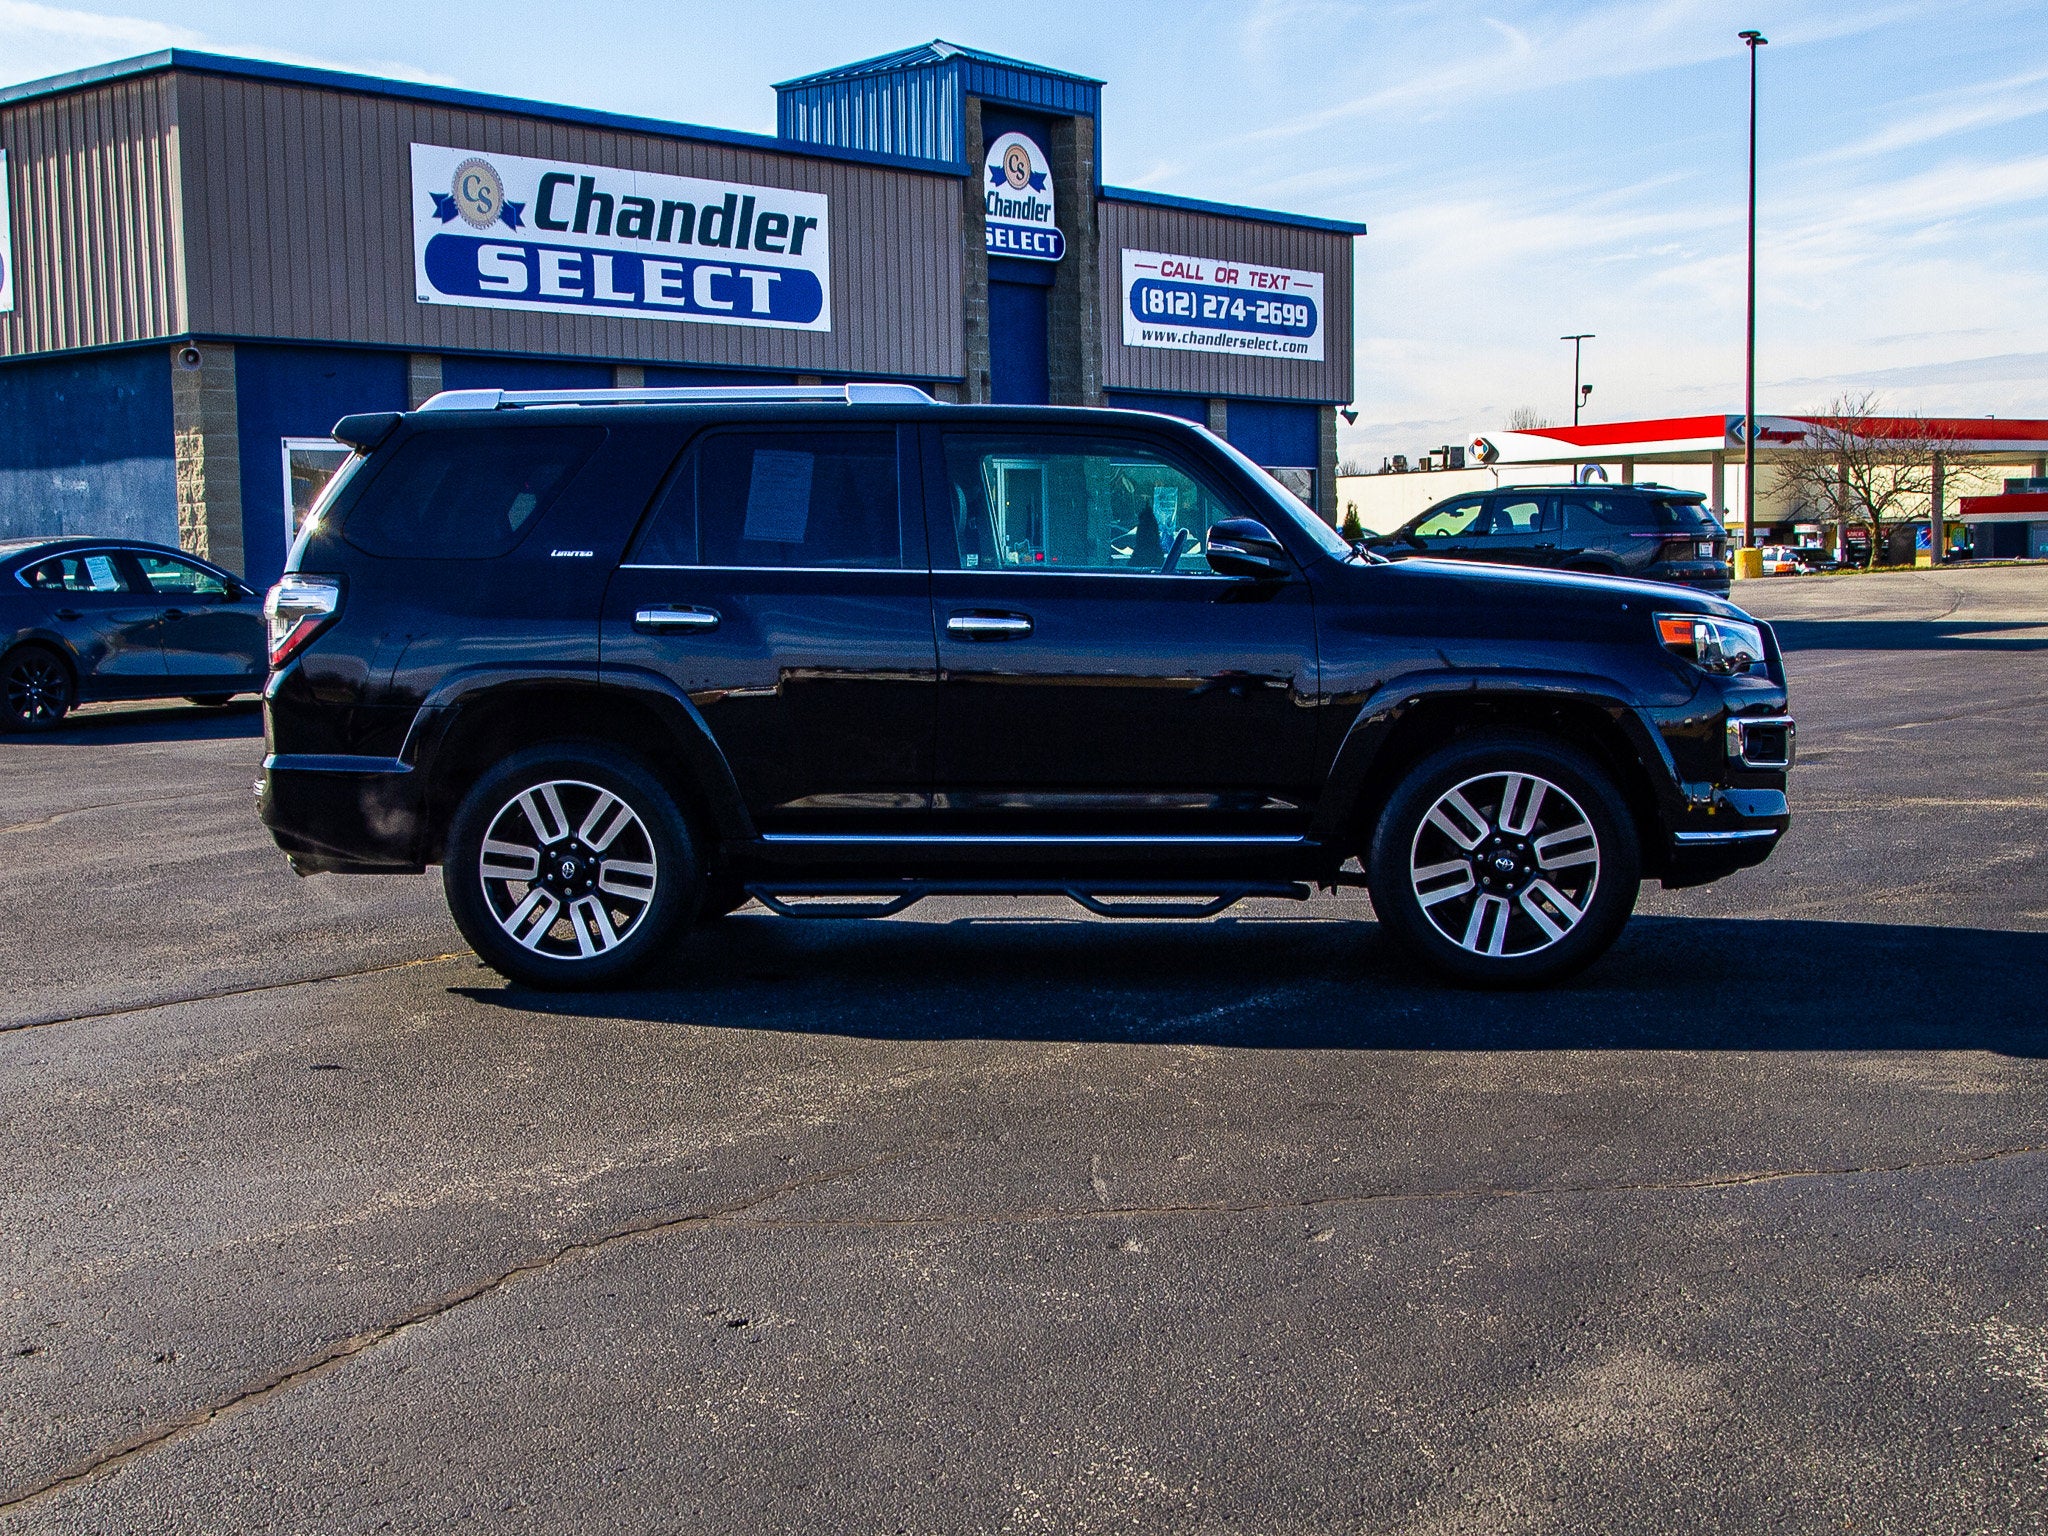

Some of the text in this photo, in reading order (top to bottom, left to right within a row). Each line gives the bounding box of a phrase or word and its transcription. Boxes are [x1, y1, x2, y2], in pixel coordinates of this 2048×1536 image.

[1009, 154, 1025, 181] CS
[462, 173, 494, 215] CS
[986, 190, 1052, 223] Chandler
[534, 171, 818, 256] Chandler
[477, 243, 782, 315] SELECT
[1160, 260, 1291, 291] CALL OR TEXT
[1141, 286, 1308, 328] (812) 274-2699
[1141, 327, 1309, 354] www.chandlerselect.com
